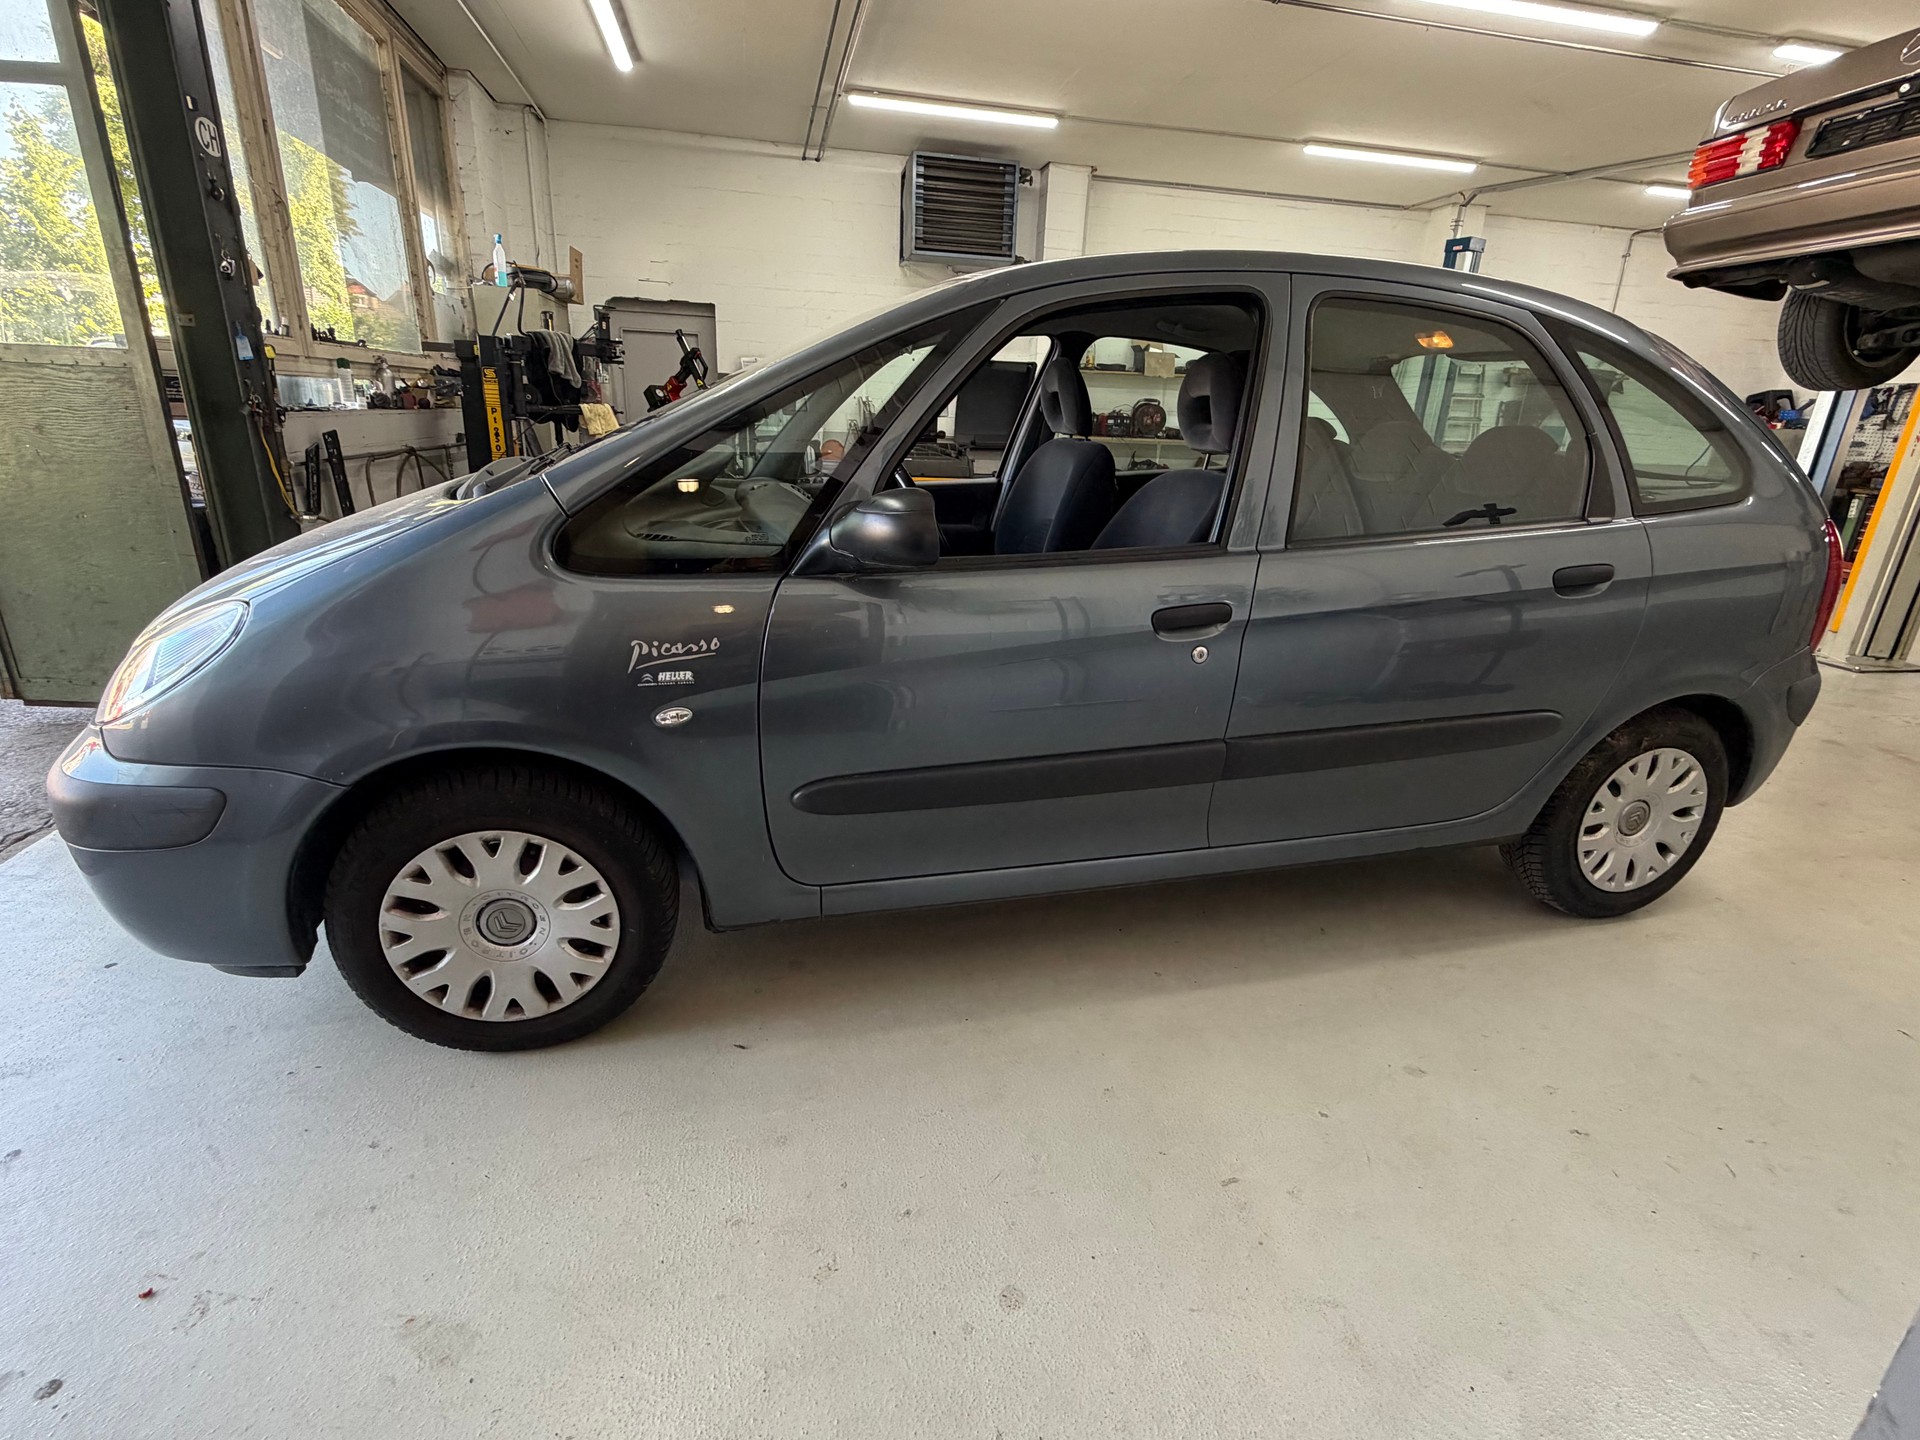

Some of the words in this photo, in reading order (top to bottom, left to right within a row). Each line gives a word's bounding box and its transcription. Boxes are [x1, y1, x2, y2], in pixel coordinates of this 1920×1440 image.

[198, 120, 221, 154] CH
[627, 637, 721, 674] Picasso
[657, 671, 695, 682] HELLER
